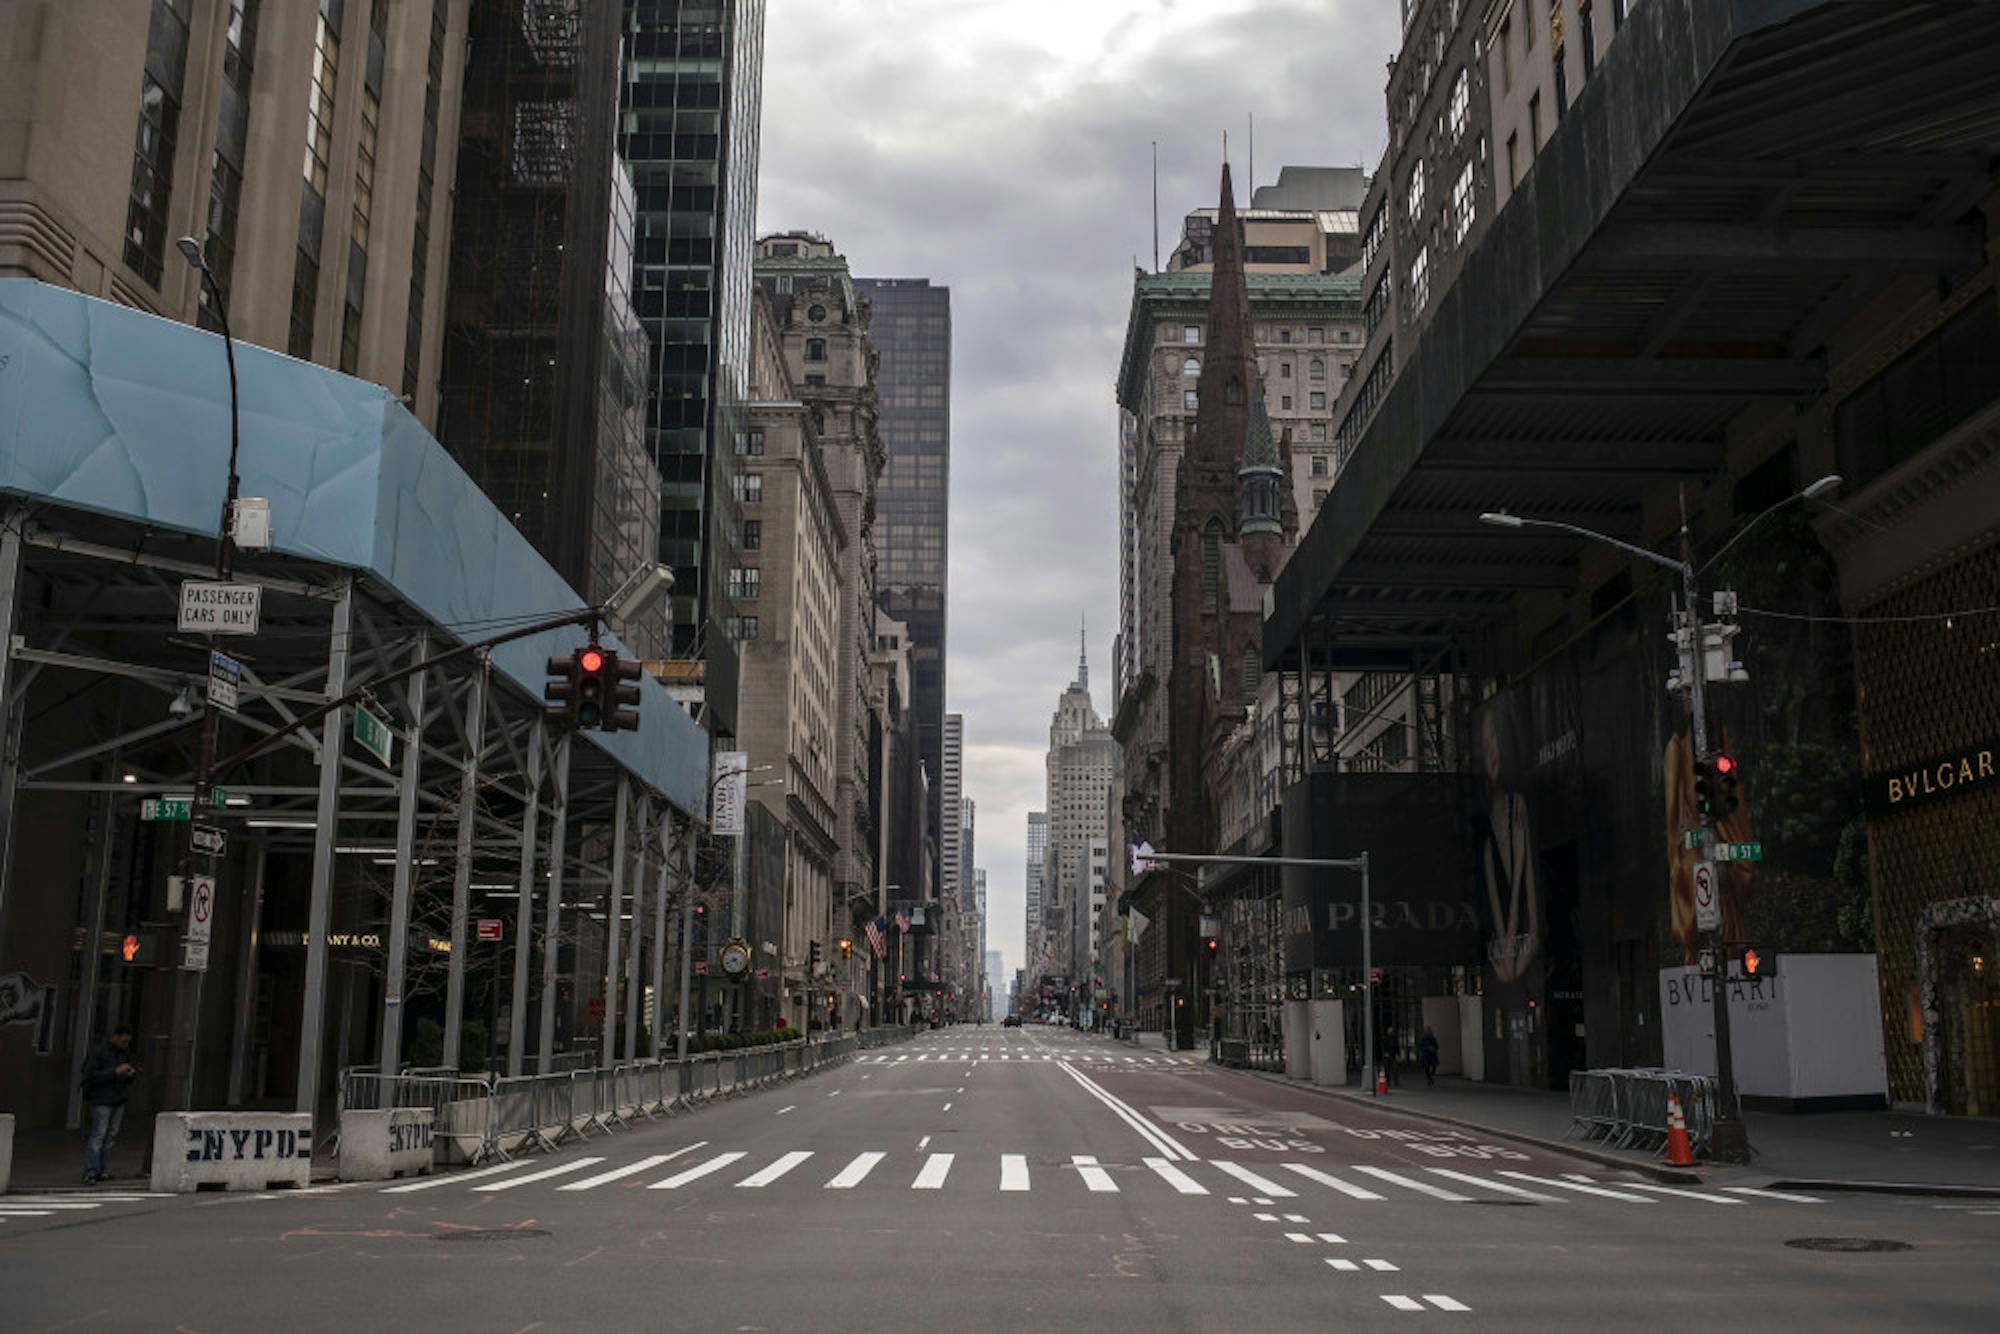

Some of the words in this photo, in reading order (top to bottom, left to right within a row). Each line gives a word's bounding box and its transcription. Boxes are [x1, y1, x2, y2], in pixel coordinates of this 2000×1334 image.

[187, 589, 255, 605] PASSENGER
[185, 608, 215, 623] CARS
[223, 609, 254, 625] ONLY
[165, 801, 178, 817] 57
[1328, 900, 1480, 930] PRADA
[1667, 974, 1776, 1006] BVLARI
[202, 1129, 297, 1160] NYPD
[395, 1122, 430, 1152] NYPD
[1216, 1136, 1325, 1153] BUS
